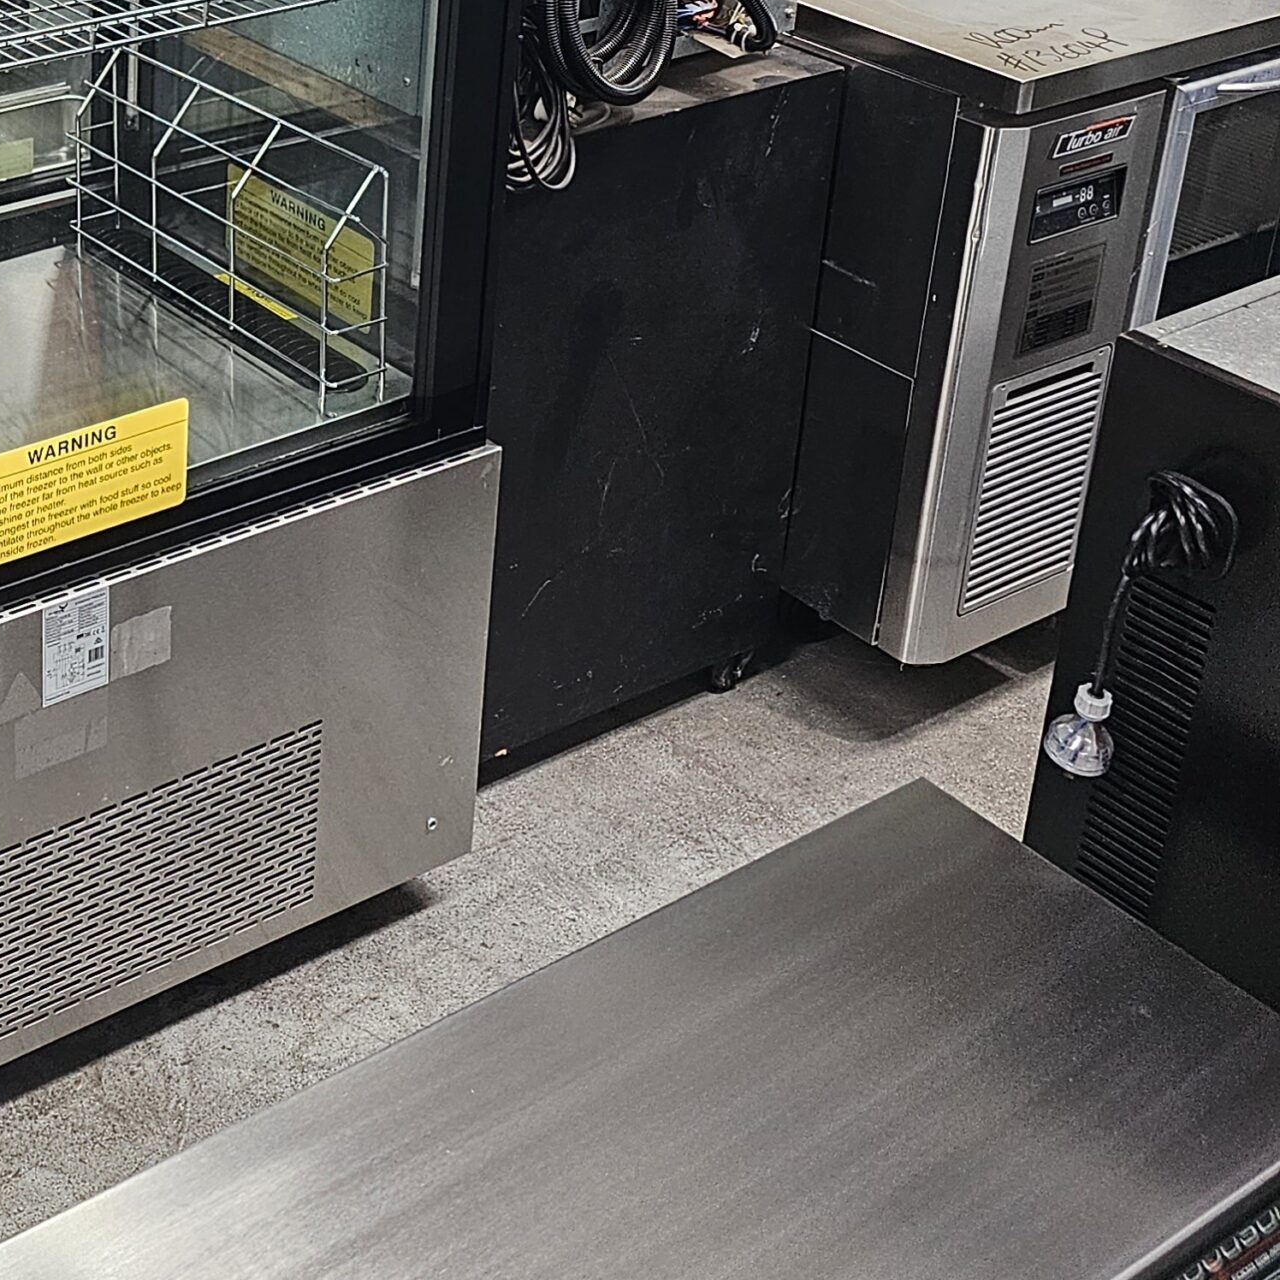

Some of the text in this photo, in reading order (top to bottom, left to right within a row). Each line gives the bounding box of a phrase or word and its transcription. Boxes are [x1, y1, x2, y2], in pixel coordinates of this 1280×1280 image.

[1066, 123, 1124, 151] Turbo air
[270, 189, 326, 232] WARNING
[26, 465, 64, 484] distance
[66, 458, 86, 472] from
[88, 451, 108, 465] both
[110, 443, 133, 457] sides
[27, 425, 117, 465] WARNING
[0, 494, 8, 505] of
[10, 487, 24, 500] the
[26, 478, 57, 496] freezer
[59, 475, 68, 485] to
[70, 469, 84, 480] the
[86, 463, 103, 475] wall
[105, 460, 114, 470] or
[116, 452, 138, 466] other
[140, 442, 173, 460] objects.
[9, 496, 40, 512] freezer
[42, 490, 54, 502] far
[56, 482, 76, 496] from
[78, 474, 97, 490] heat
[99, 466, 129, 483] source
[130, 459, 151, 473] such
[152, 455, 163, 466] as
[25, 509, 34, 519] or
[36, 498, 67, 514] heater.
[26, 514, 76, 540] throughout
[77, 510, 90, 523] the
[92, 502, 118, 518] whole
[120, 491, 149, 508] freezer
[150, 487, 160, 498] to
[160, 480, 182, 495] keep
[31, 515, 46, 528] the
[48, 504, 78, 520] freezer
[80, 497, 97, 511] with
[99, 491, 119, 505] food
[120, 483, 140, 497] stuff
[141, 479, 152, 491] so
[153, 472, 172, 487] cool
[26, 534, 57, 550] frozen.
